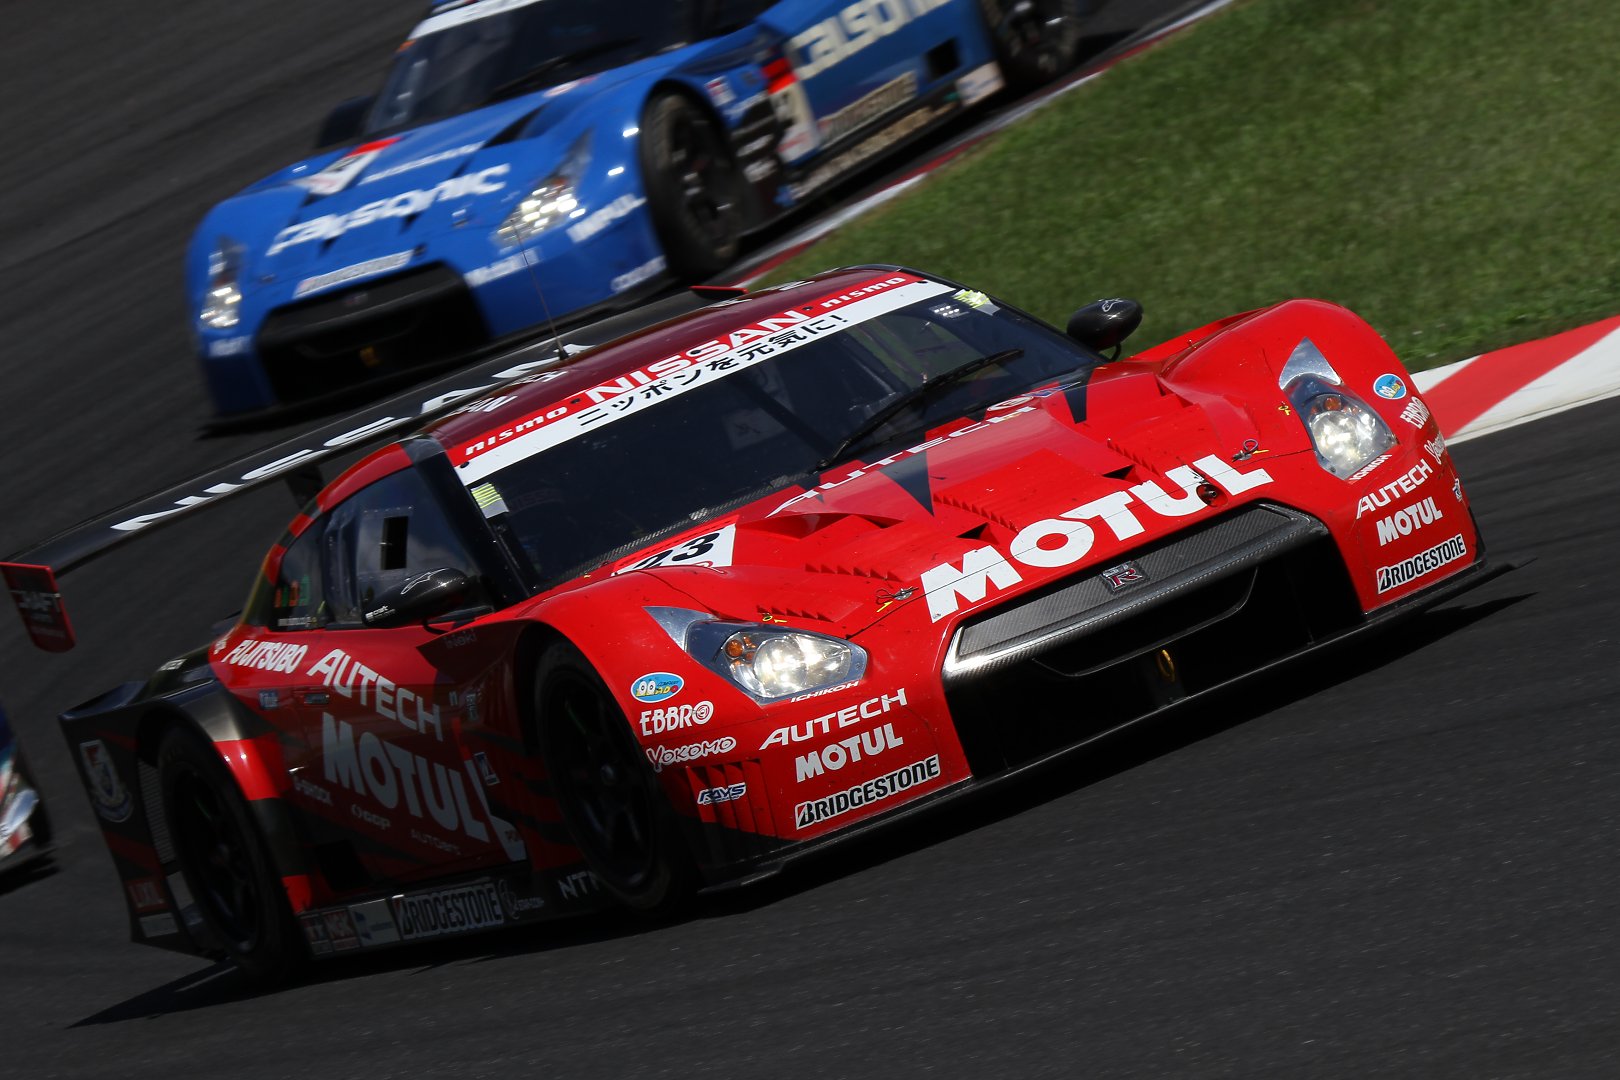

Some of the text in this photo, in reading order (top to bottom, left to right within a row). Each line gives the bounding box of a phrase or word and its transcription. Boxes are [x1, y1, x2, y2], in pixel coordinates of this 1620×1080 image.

[464, 276, 906, 456] nismo NISSAN nismo
[1356, 458, 1433, 519] AUTECH
[920, 453, 1273, 622] MOTUL
[1376, 496, 1442, 546] MOTUL
[1377, 534, 1466, 594] BRIDGESTONE
[221, 639, 309, 674] FUJITSUBO
[307, 649, 444, 743] AUTECH
[639, 700, 714, 737] EBBRO
[758, 687, 908, 751] AUTECH
[323, 711, 489, 844] MOTUL
[795, 723, 903, 783] MOTUL
[796, 754, 941, 829] BRIDGESTONE
[394, 883, 504, 941] BRIDGESTONE
